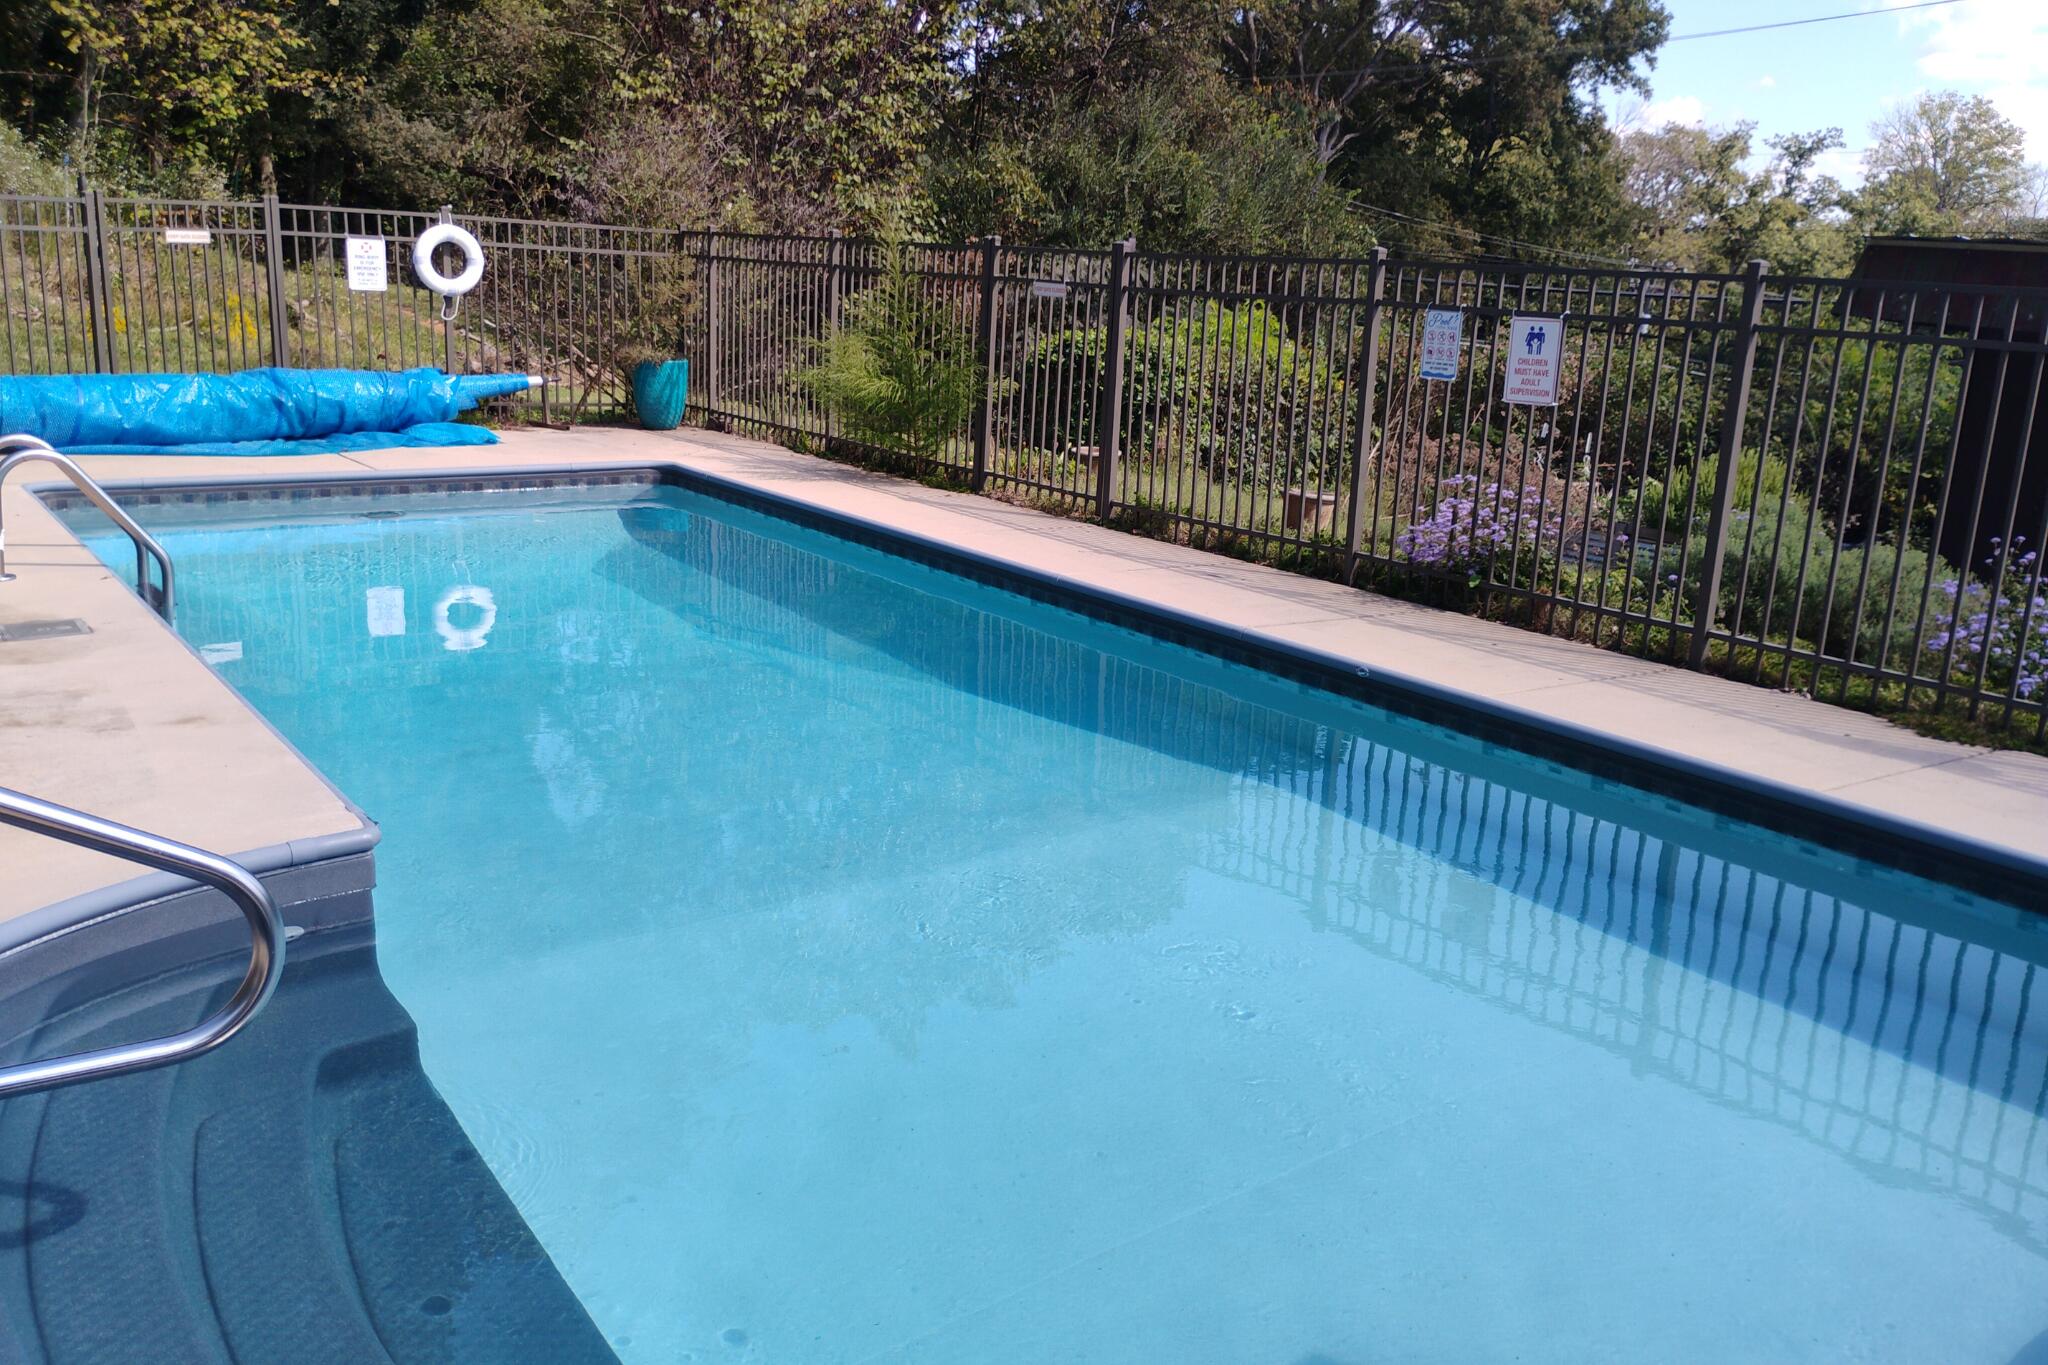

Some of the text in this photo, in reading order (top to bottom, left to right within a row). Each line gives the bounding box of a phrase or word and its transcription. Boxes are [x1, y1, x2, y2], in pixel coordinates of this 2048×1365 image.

[1517, 357, 1549, 366] CHILDREN
[1514, 367, 1550, 377] MUST HAVE
[1520, 377, 1541, 386] ADULT
[1509, 386, 1551, 397] SUPERVISION
